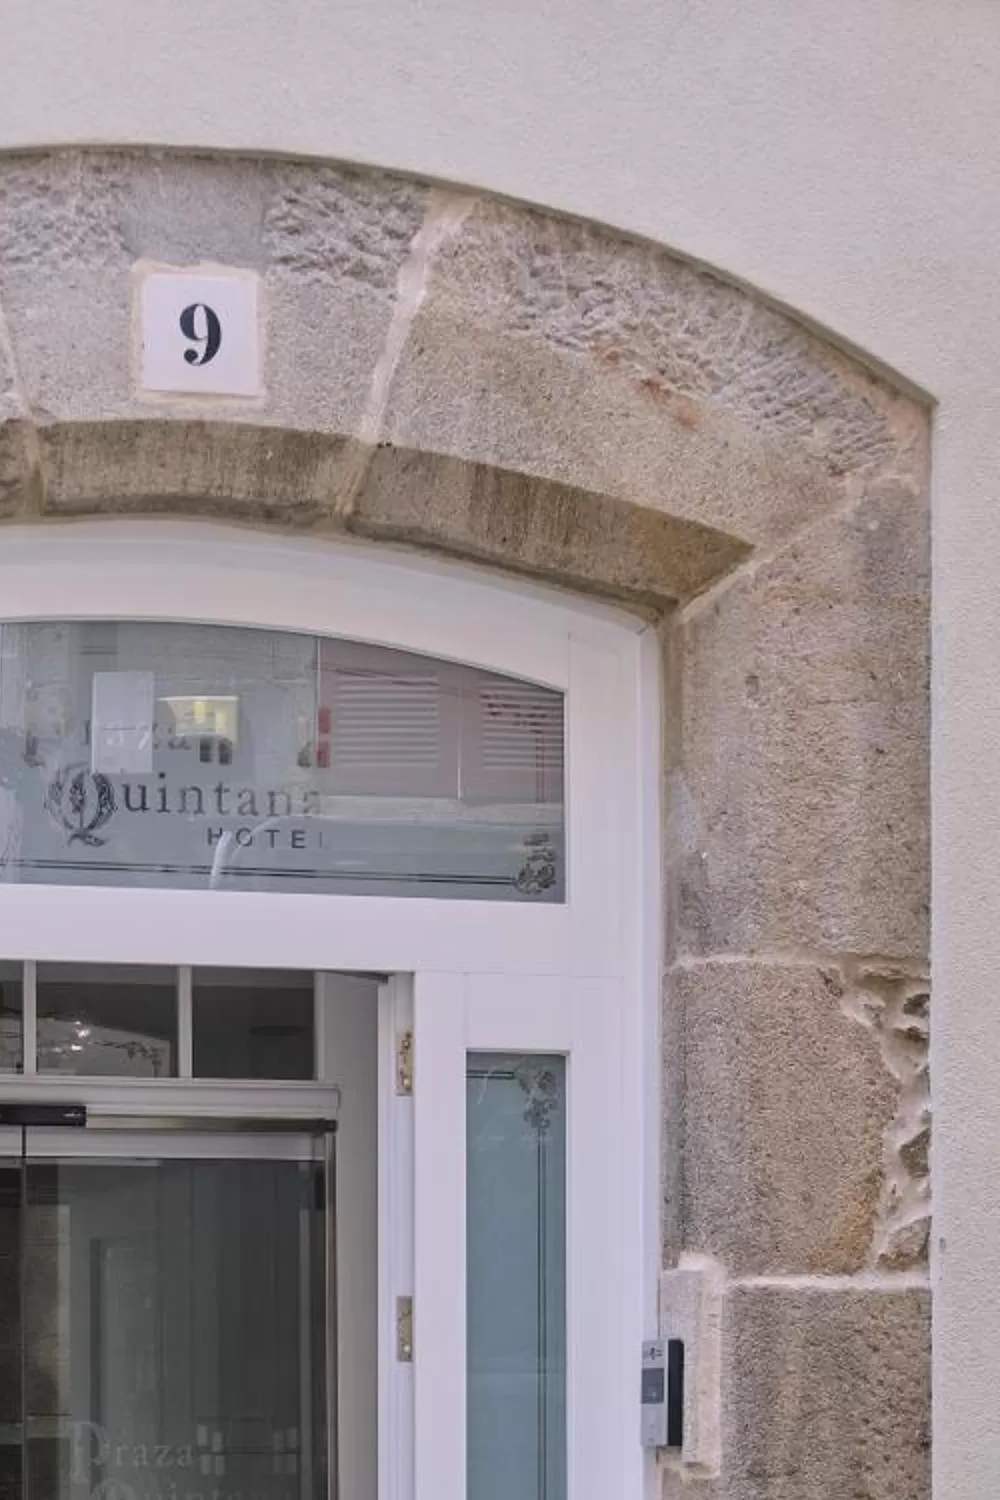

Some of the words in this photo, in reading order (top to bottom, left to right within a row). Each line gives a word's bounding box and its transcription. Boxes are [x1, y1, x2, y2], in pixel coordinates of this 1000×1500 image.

[179, 303, 222, 366] 9
[43, 762, 321, 848] Quintana
[62, 1420, 193, 1485] Praza
